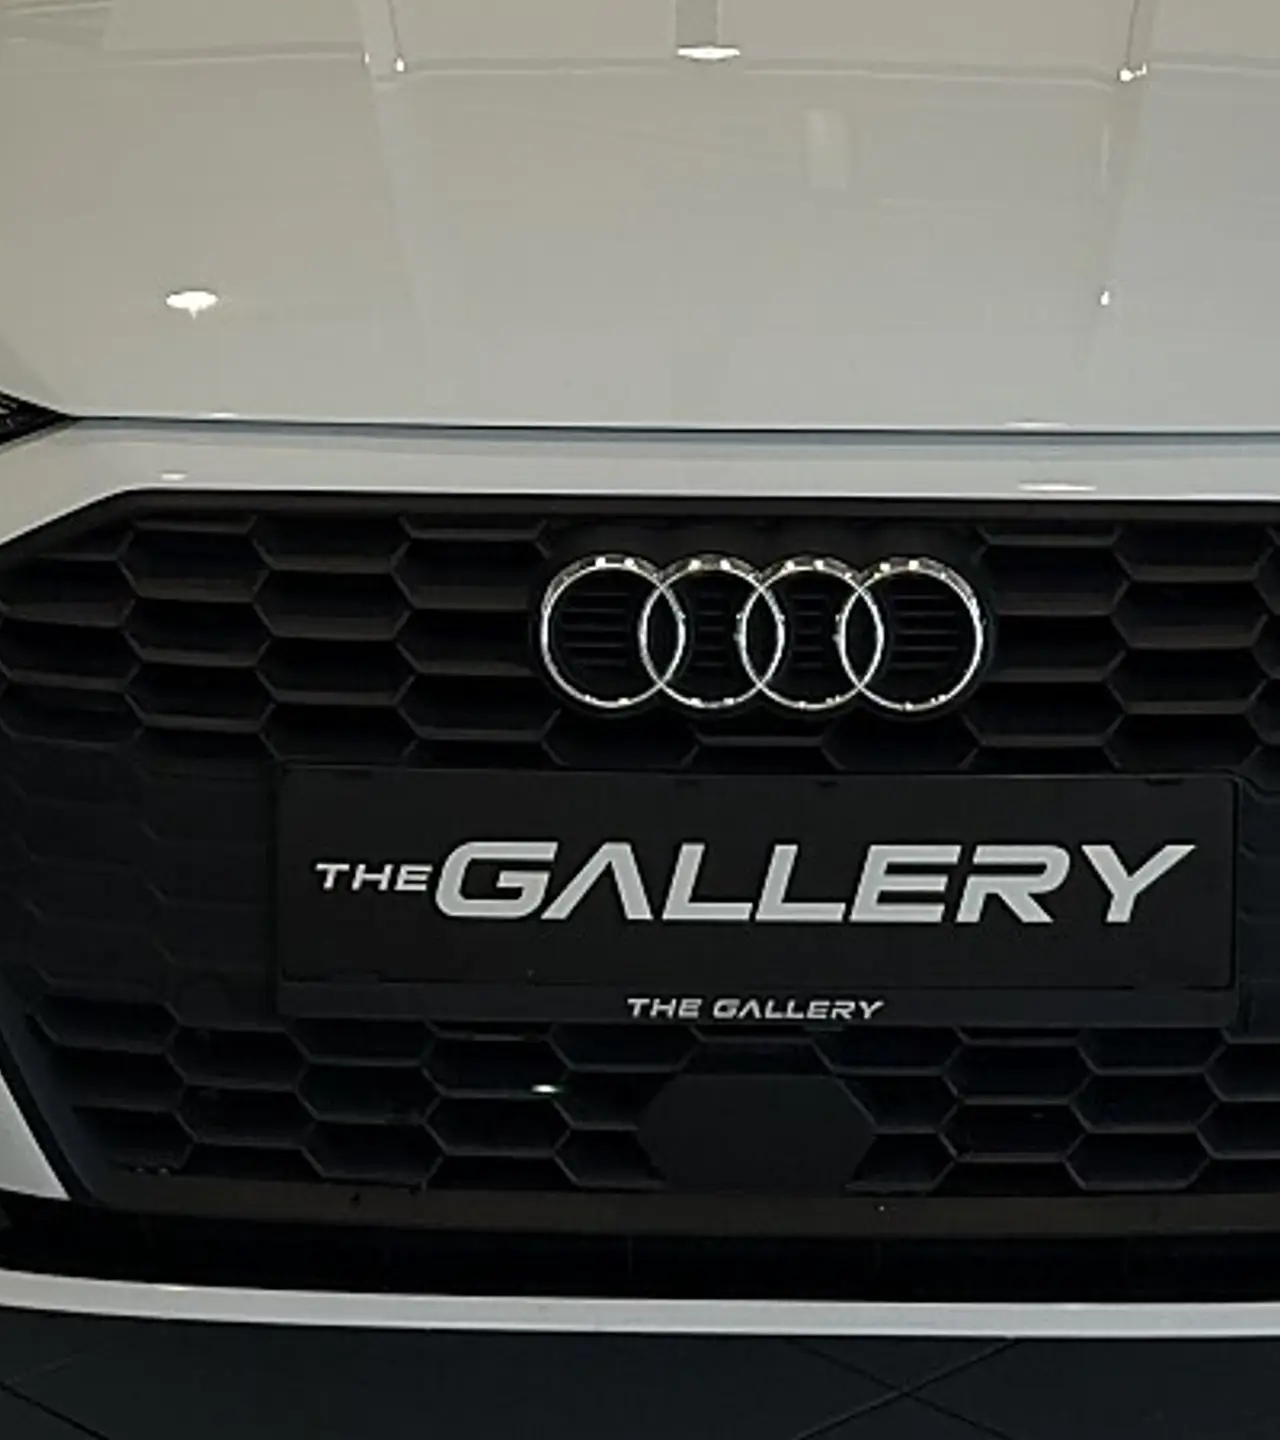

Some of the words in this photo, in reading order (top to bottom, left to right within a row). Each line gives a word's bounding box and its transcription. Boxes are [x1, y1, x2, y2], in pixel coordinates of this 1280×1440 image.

[314, 862, 433, 891] THE
[435, 841, 1197, 923] GALLERY
[626, 997, 703, 1019] THE
[712, 998, 885, 1019] GALLERY
